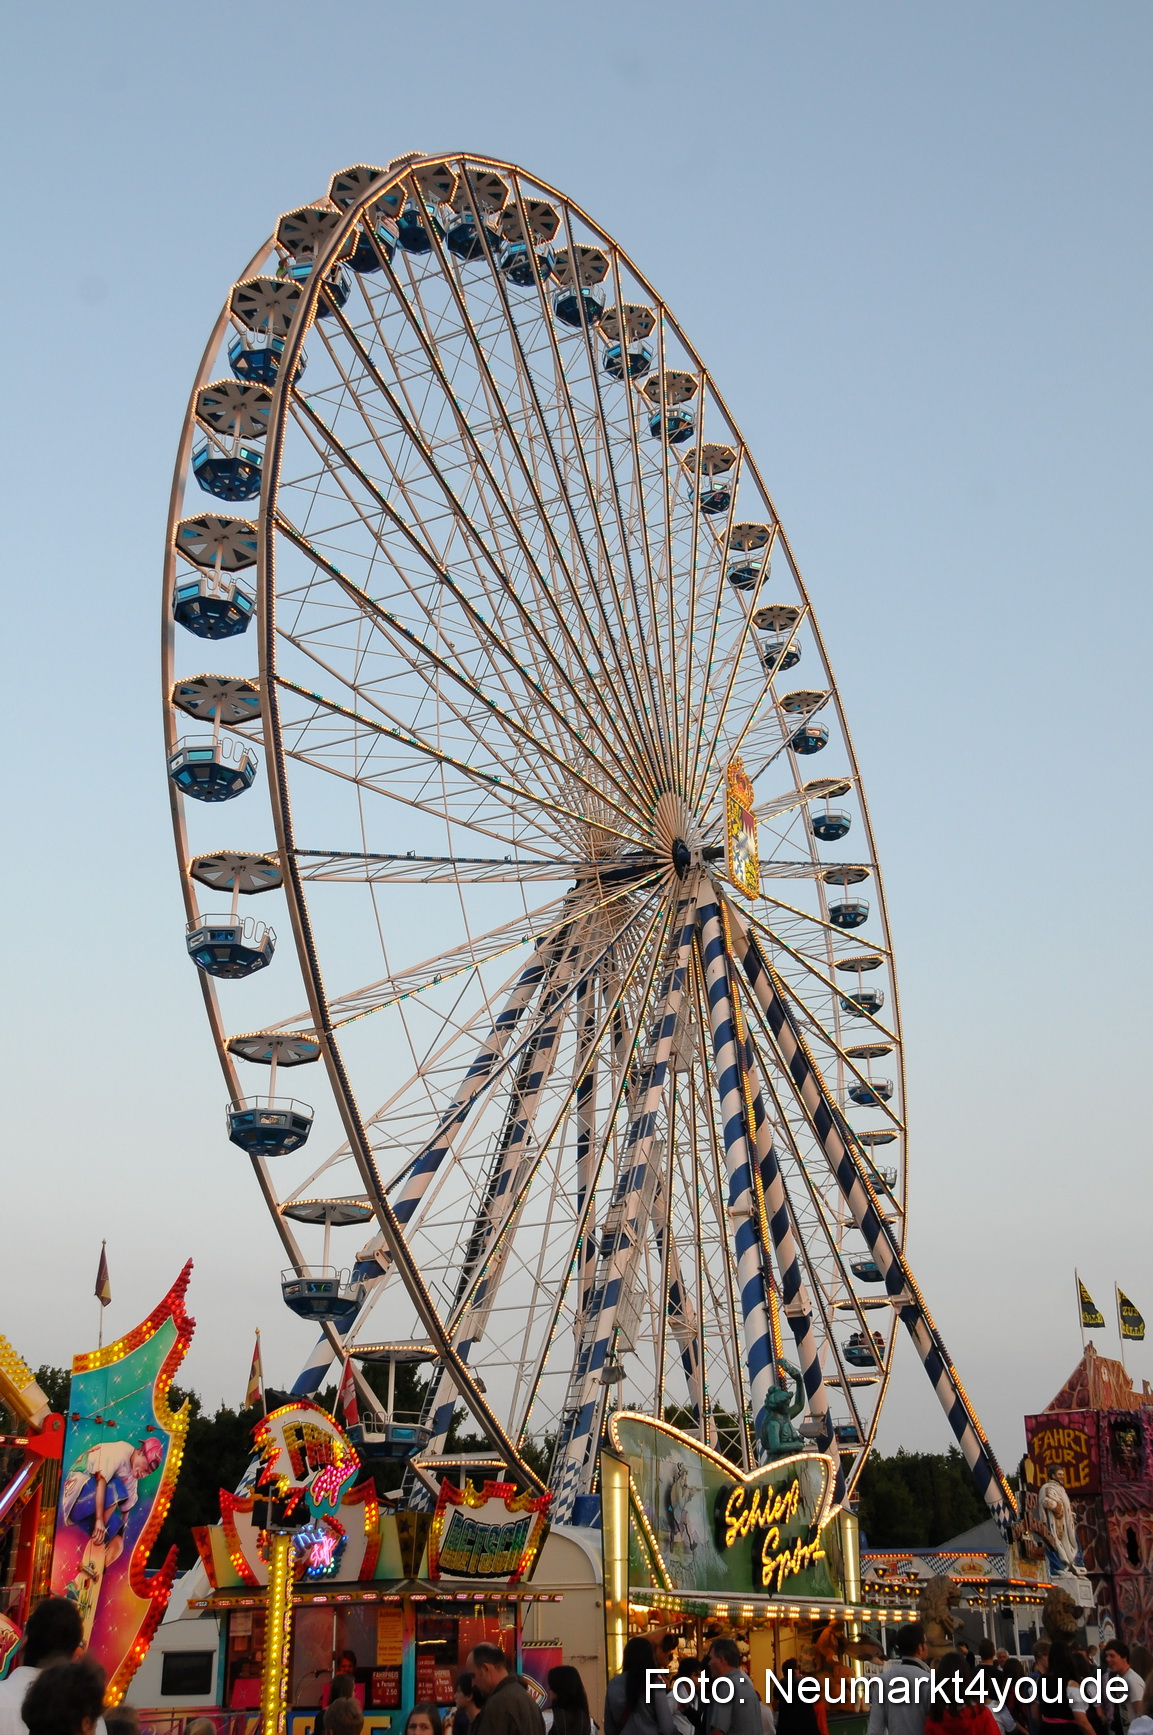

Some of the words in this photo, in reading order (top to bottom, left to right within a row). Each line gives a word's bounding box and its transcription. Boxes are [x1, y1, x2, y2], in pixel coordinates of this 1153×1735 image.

[1032, 1428, 1088, 1455] FAHRT
[1043, 1449, 1076, 1465] ZUR
[1036, 1459, 1090, 1489] HLLE
[762, 1526, 826, 1593] Sport
